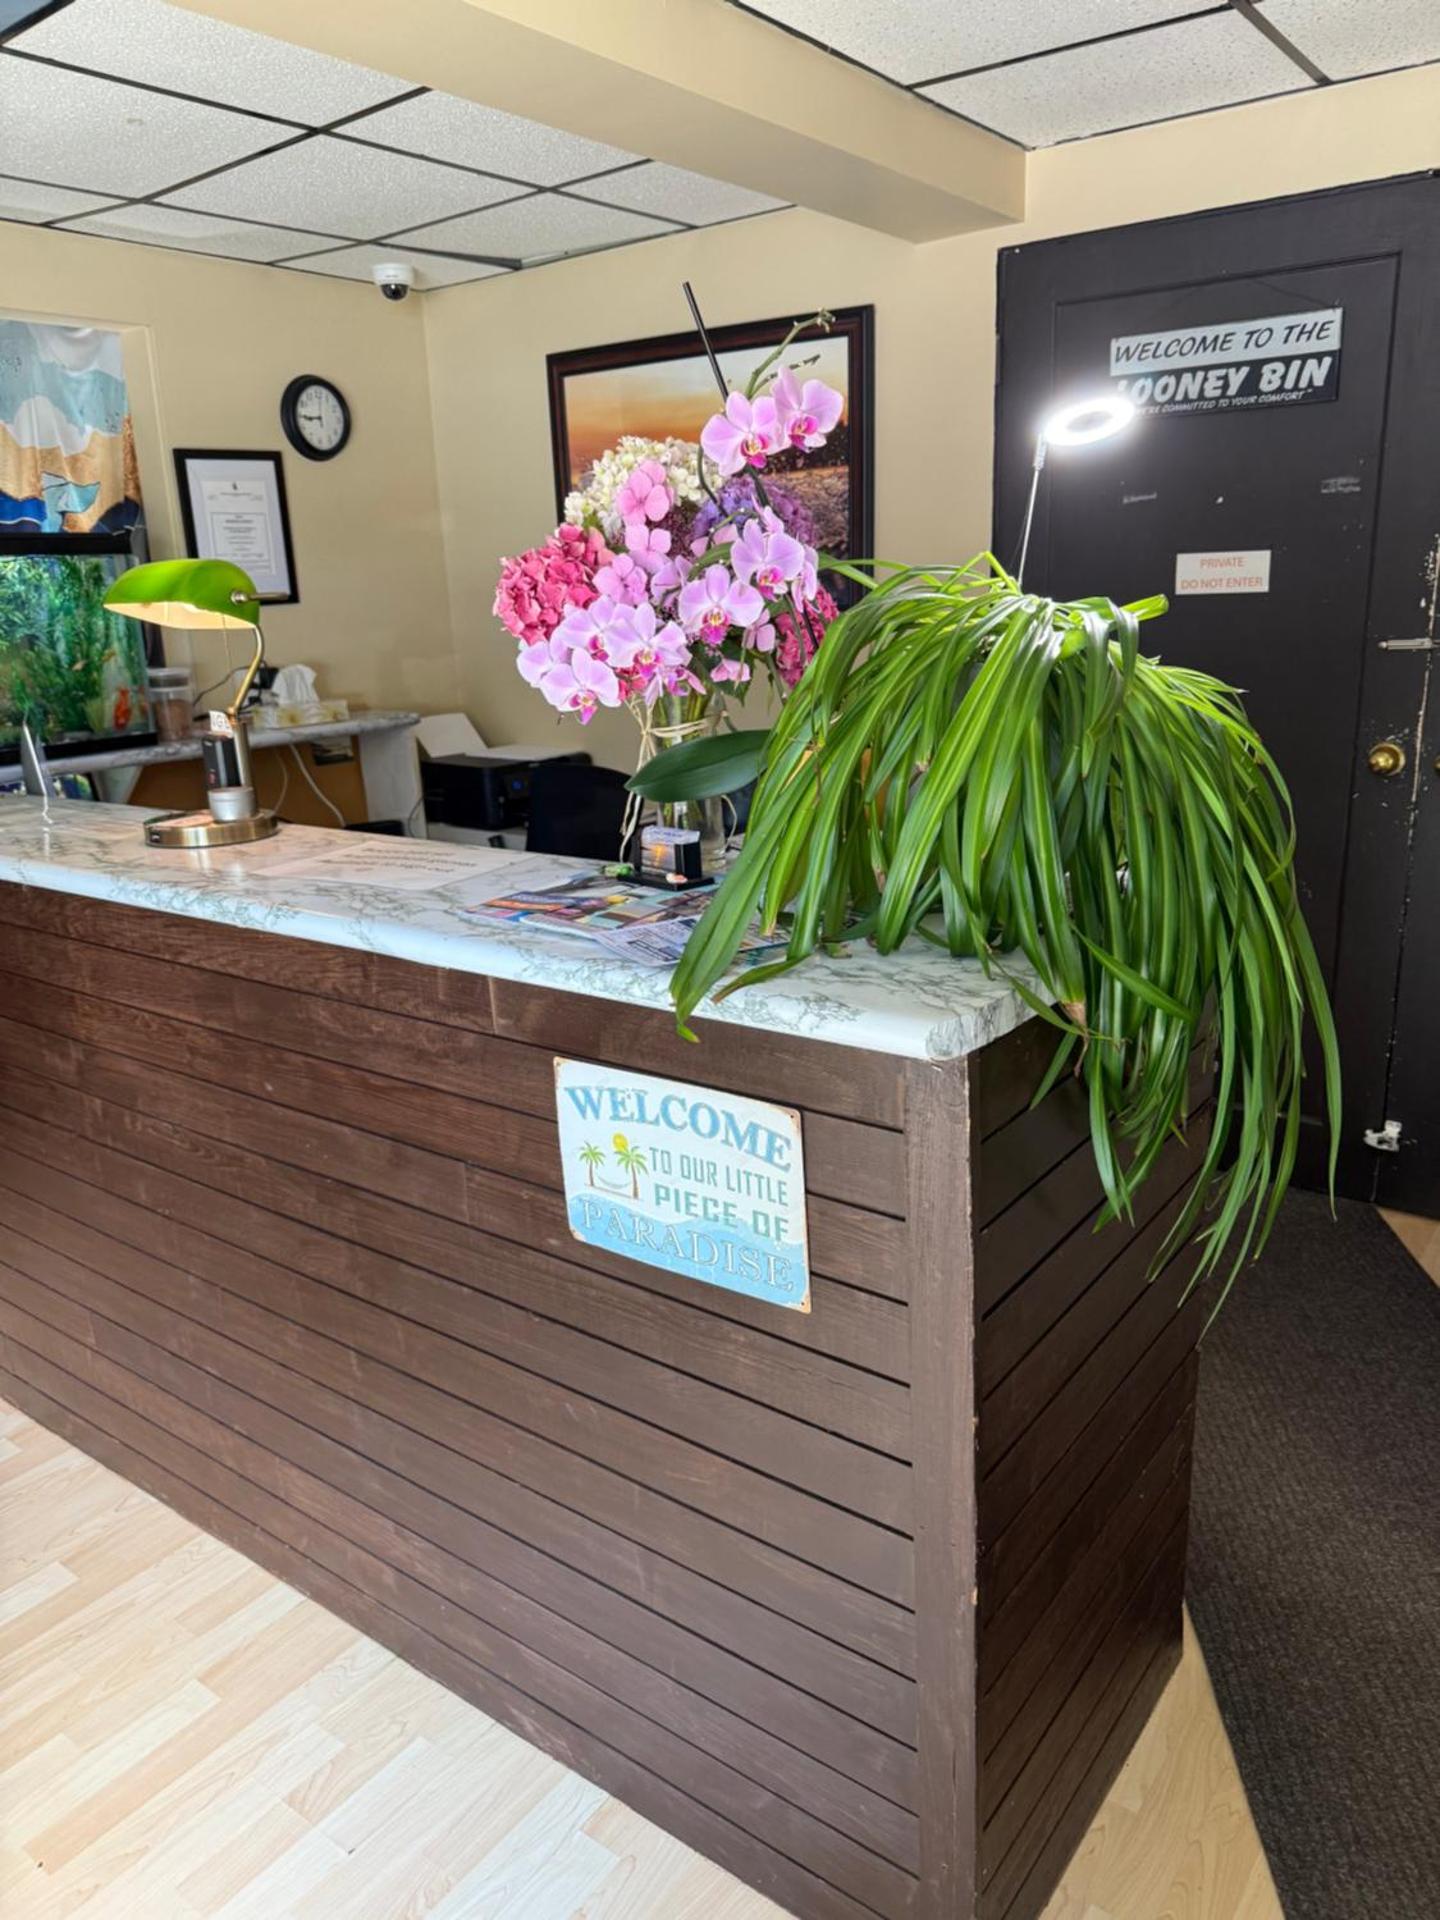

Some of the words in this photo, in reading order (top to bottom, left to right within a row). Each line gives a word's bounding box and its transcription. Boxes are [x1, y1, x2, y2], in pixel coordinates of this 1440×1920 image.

[1115, 332, 1237, 363] WELCOME
[1244, 326, 1274, 350] TO
[1283, 320, 1335, 345] THE
[1258, 355, 1333, 393] BIN
[1218, 398, 1229, 408] TO
[1231, 395, 1258, 407] YOUR
[1180, 579, 1199, 590] DO
[1200, 578, 1225, 589] NOT
[1226, 575, 1264, 588] ENTER
[1199, 556, 1246, 569] PRIVATE
[563, 1085, 792, 1173] WELCOME
[649, 1147, 672, 1175] TO
[680, 1154, 718, 1187] OUR
[726, 1164, 789, 1208] LITTLE
[654, 1183, 738, 1229] PIECE
[753, 1210, 789, 1243] OF
[580, 1199, 794, 1294] PARADISE
